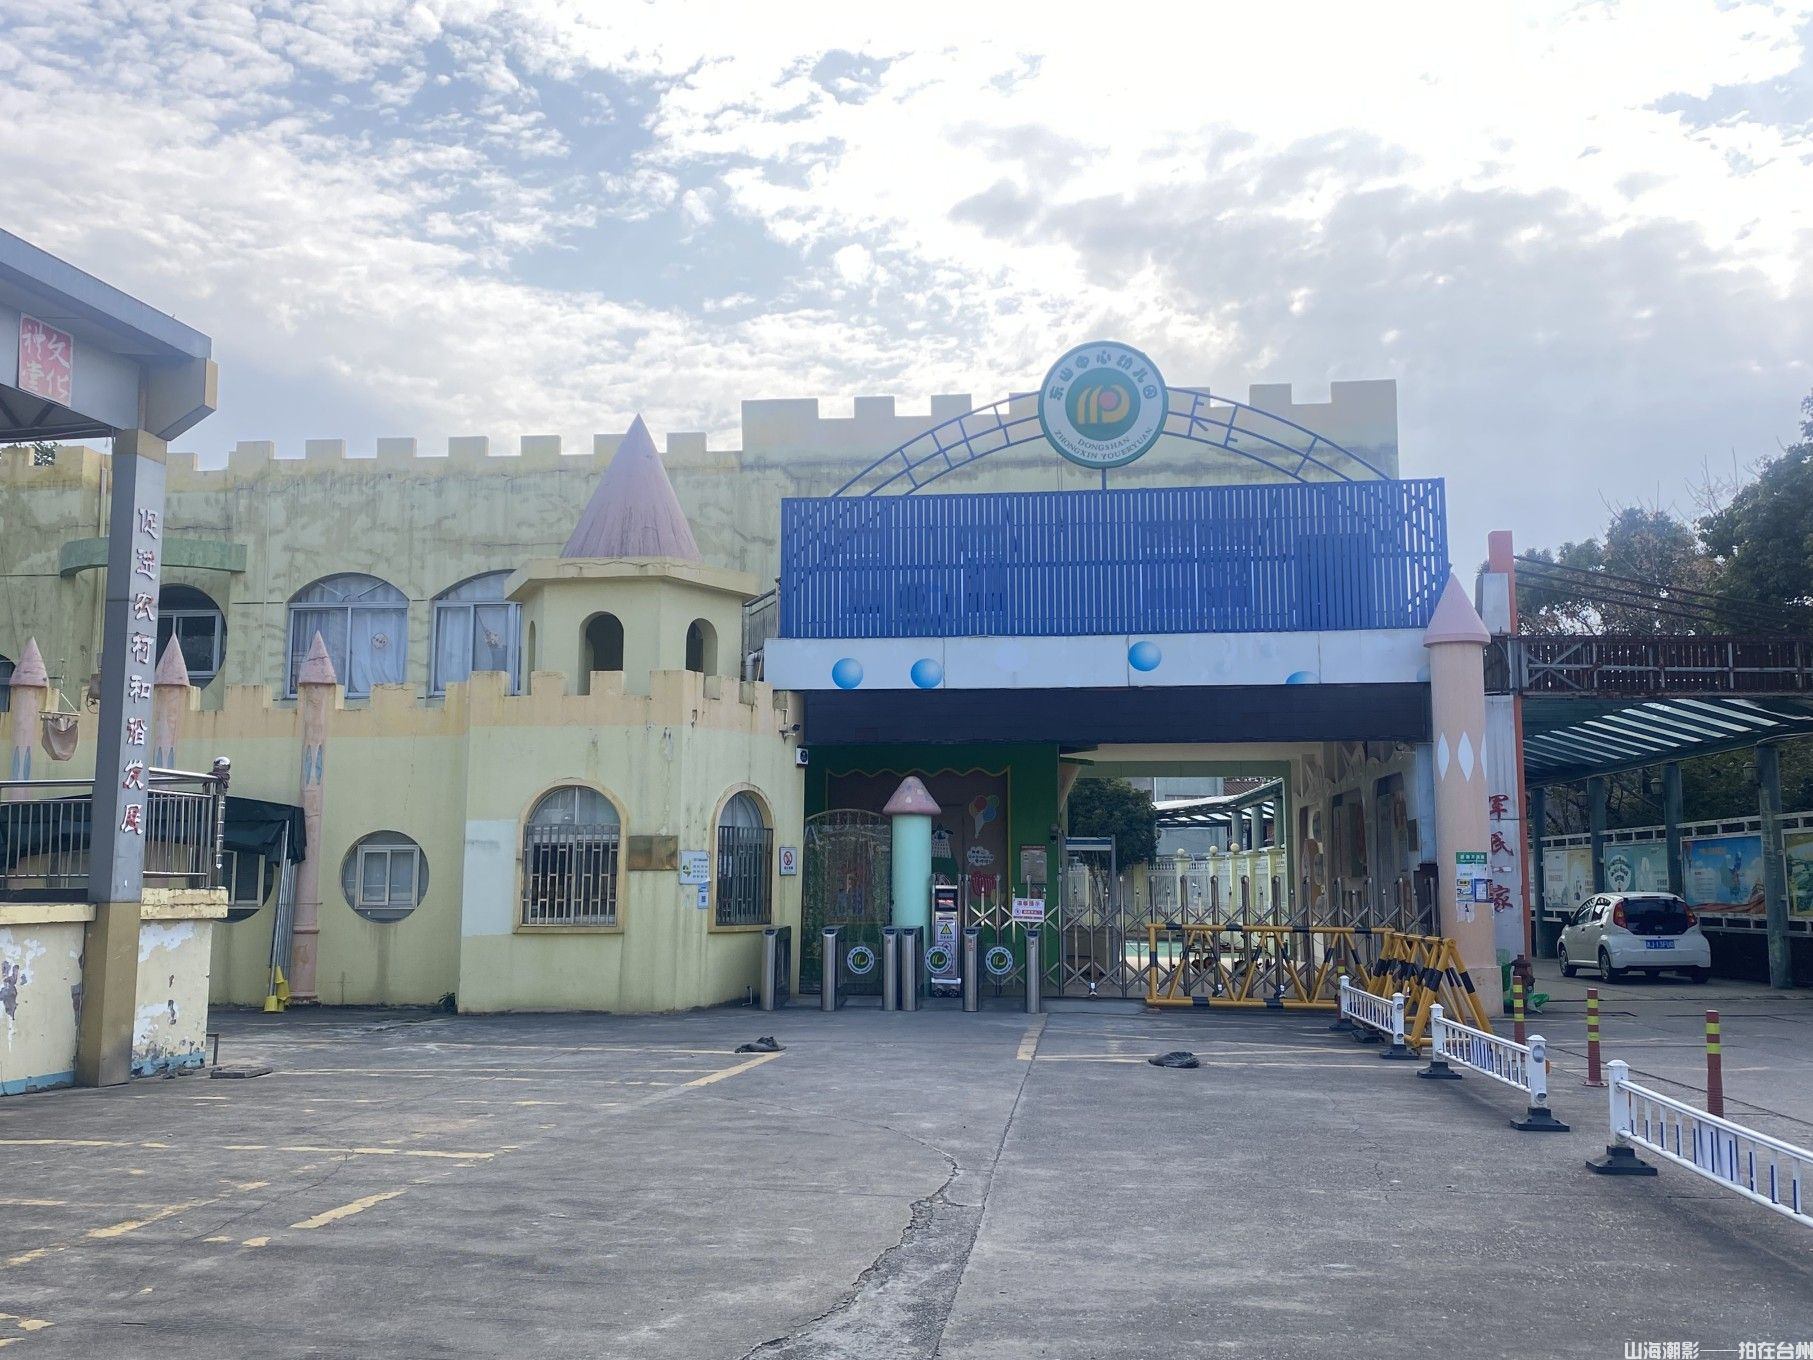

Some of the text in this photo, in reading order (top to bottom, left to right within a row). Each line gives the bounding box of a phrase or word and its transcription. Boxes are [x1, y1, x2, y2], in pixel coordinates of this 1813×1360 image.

[46, 333, 71, 399] 文化
[1049, 350, 1158, 401] 东山中心幼儿园
[1054, 426, 1153, 460] ZHONGXIN YOUERYUAN
[1078, 436, 1130, 451] DONGSHAN
